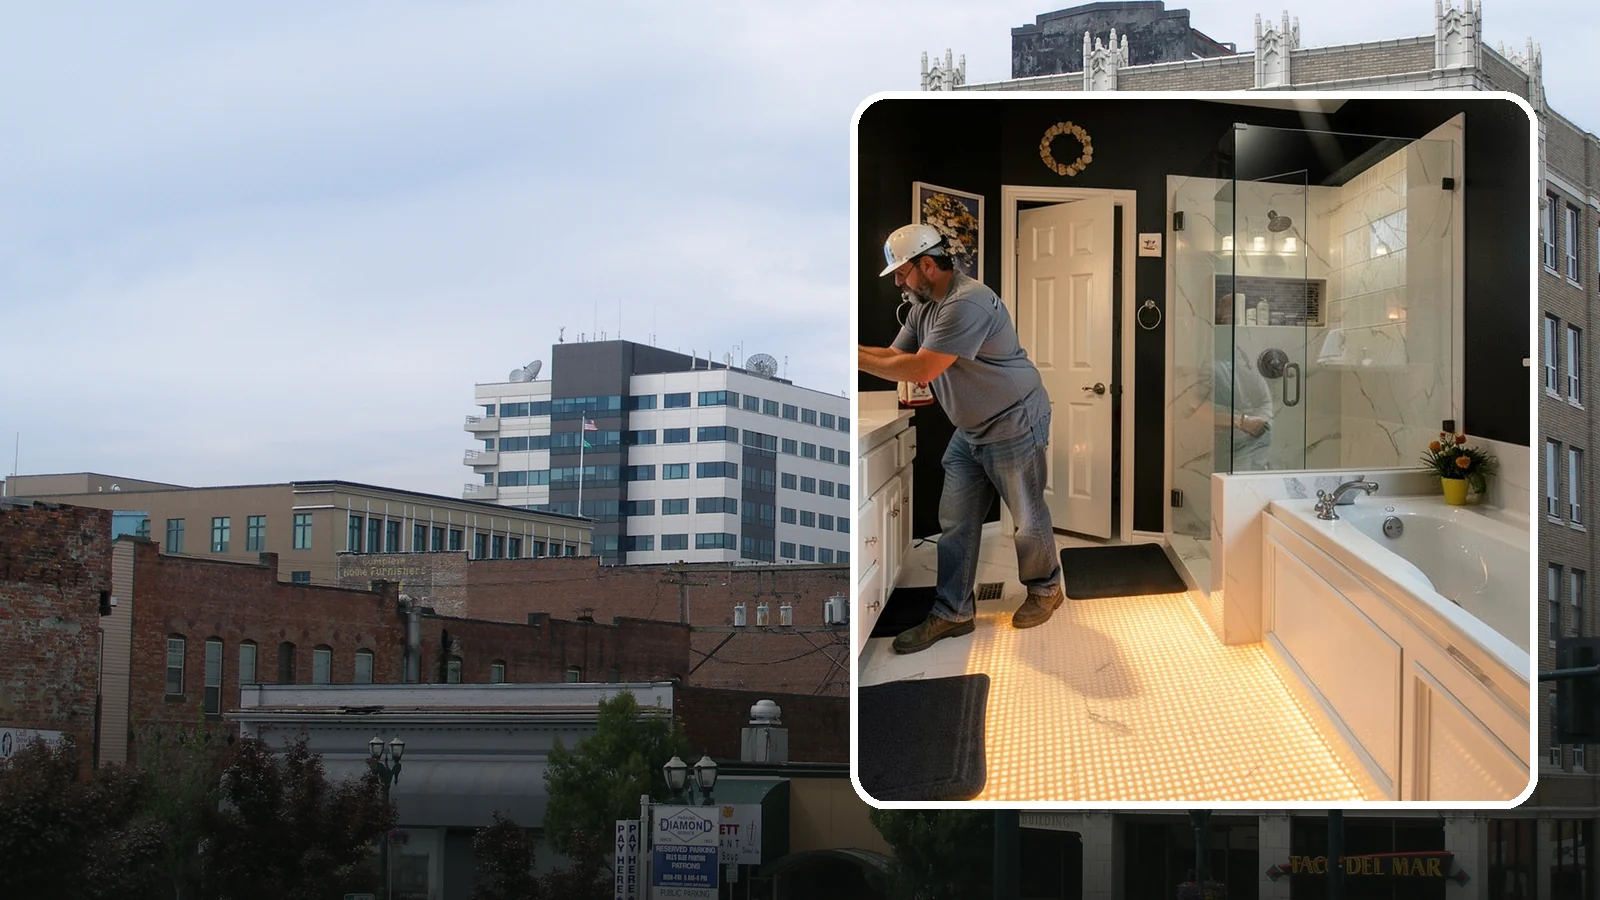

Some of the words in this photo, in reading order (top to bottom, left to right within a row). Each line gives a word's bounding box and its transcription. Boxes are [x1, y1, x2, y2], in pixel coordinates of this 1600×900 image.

[343, 568, 368, 577] Home
[370, 566, 427, 576] Furnishers
[660, 818, 713, 832] DIAMOND
[1022, 816, 1070, 828] BUILDING
[617, 825, 625, 852] PAY
[628, 824, 636, 852] PAY
[722, 852, 739, 862] Soup
[616, 856, 624, 894] HERE
[628, 856, 636, 893] HERE
[1289, 856, 1329, 874] TAC
[1346, 856, 1385, 876] DEL
[1392, 858, 1442, 877] MAR
[660, 889, 682, 897] PUBLIC
[684, 889, 710, 898] PARKING
